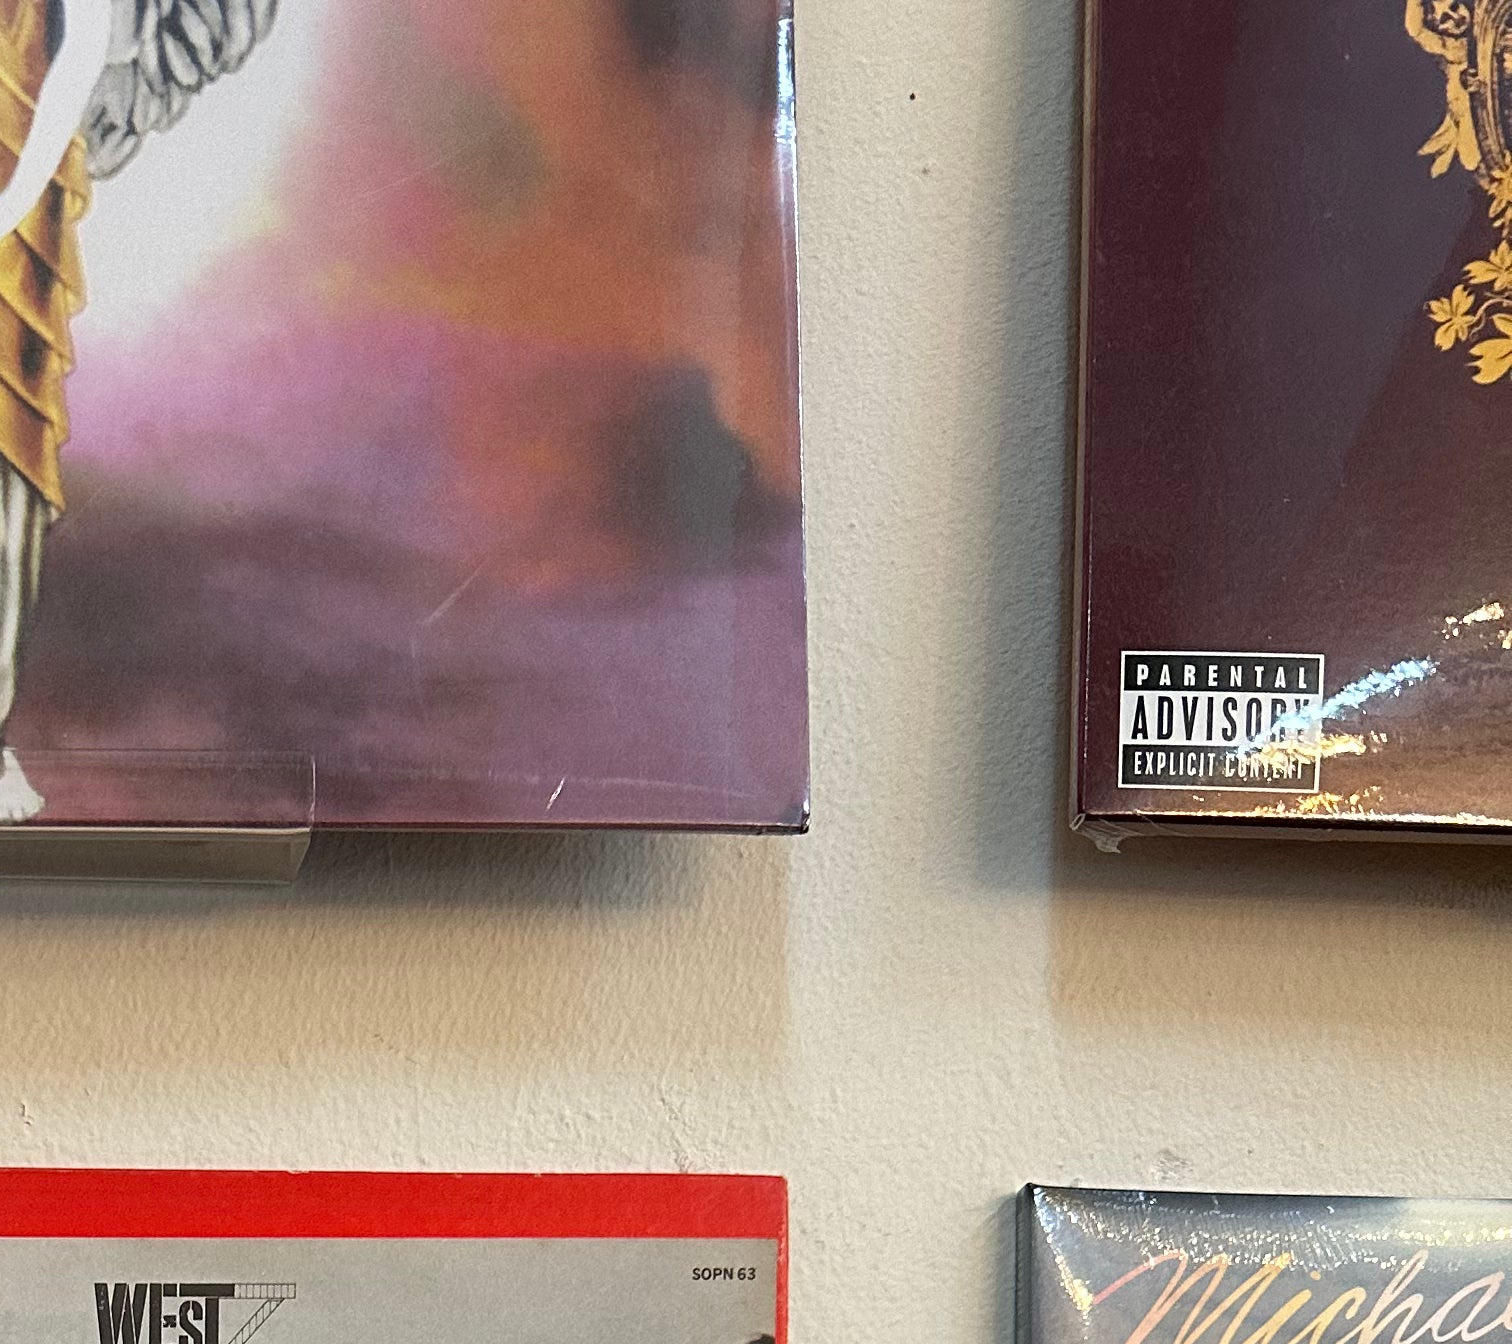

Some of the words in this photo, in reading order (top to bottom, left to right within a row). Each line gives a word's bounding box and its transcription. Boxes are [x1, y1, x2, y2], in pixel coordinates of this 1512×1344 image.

[1136, 664, 1307, 689] PARENTAL
[1133, 750, 1216, 777] EXPLICIT
[691, 1267, 734, 1281] SOPN
[737, 1267, 757, 1281] 63
